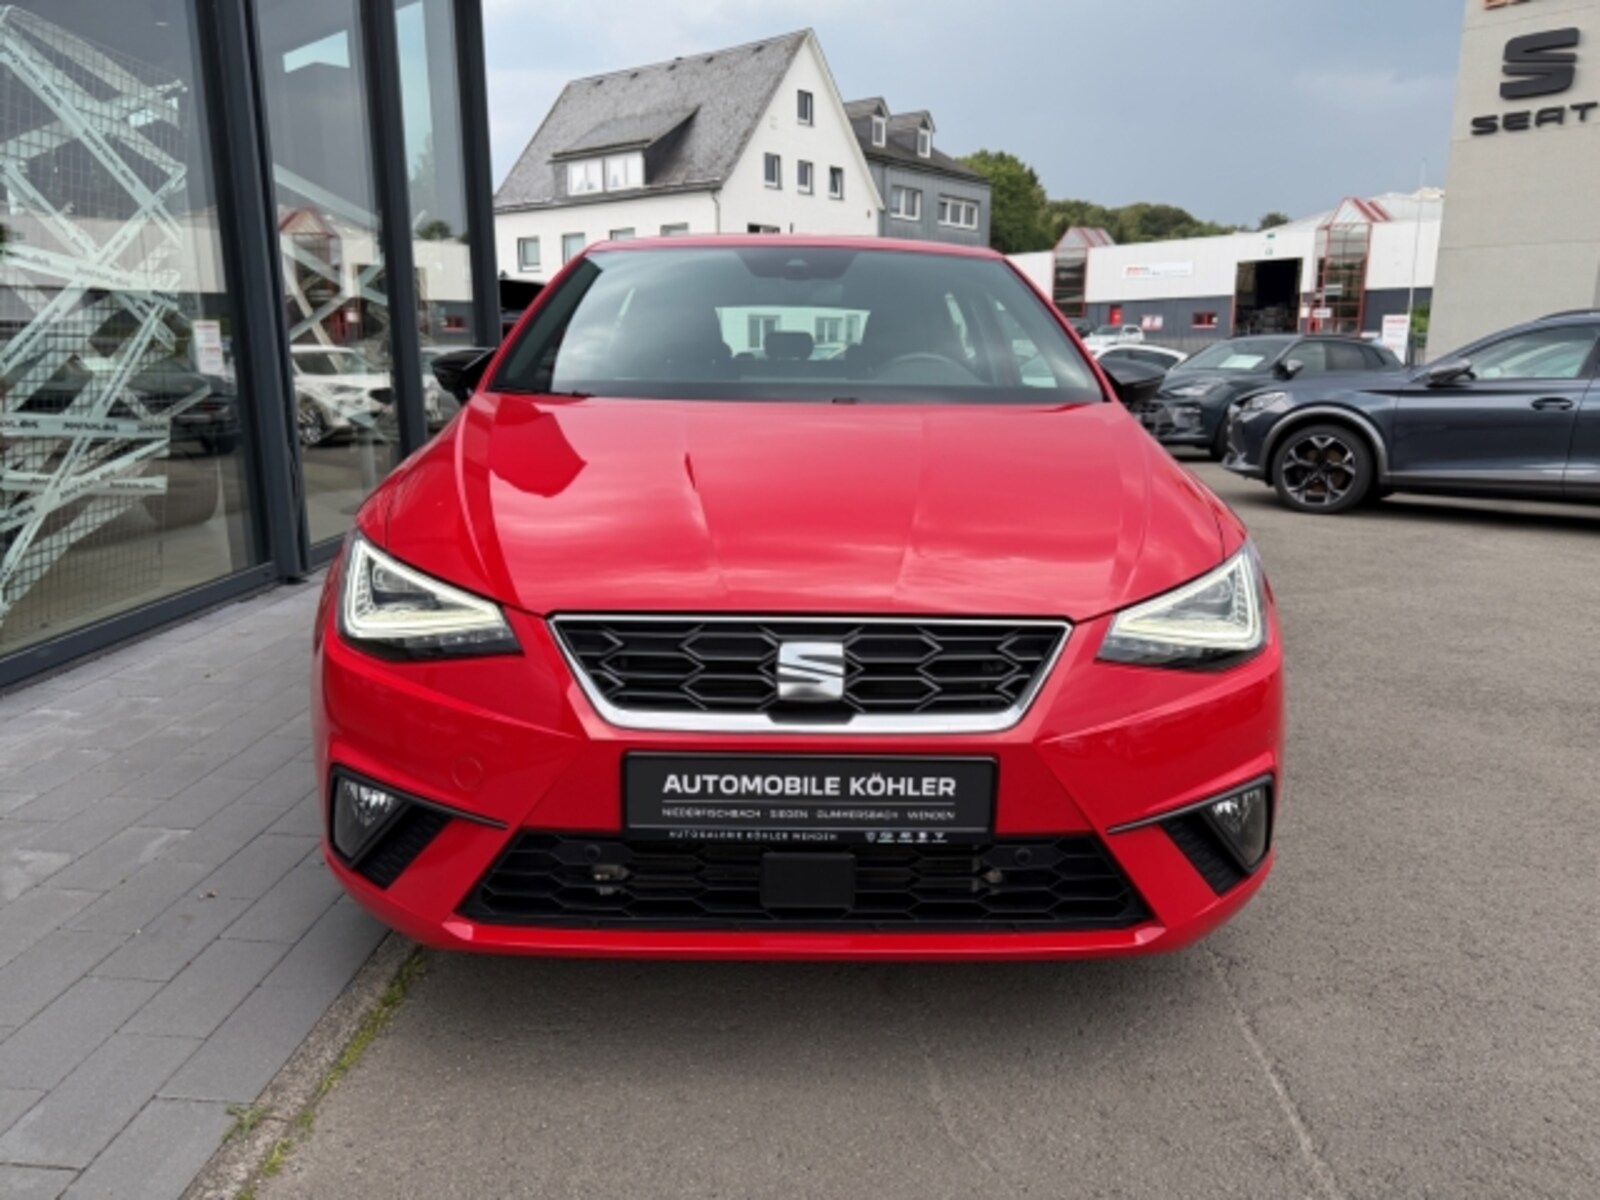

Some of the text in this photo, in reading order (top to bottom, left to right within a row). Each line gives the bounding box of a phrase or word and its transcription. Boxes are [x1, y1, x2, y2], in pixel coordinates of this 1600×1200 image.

[1470, 101, 1599, 136] SEAT
[662, 772, 957, 797] AUTOMOBILE KÖHLER
